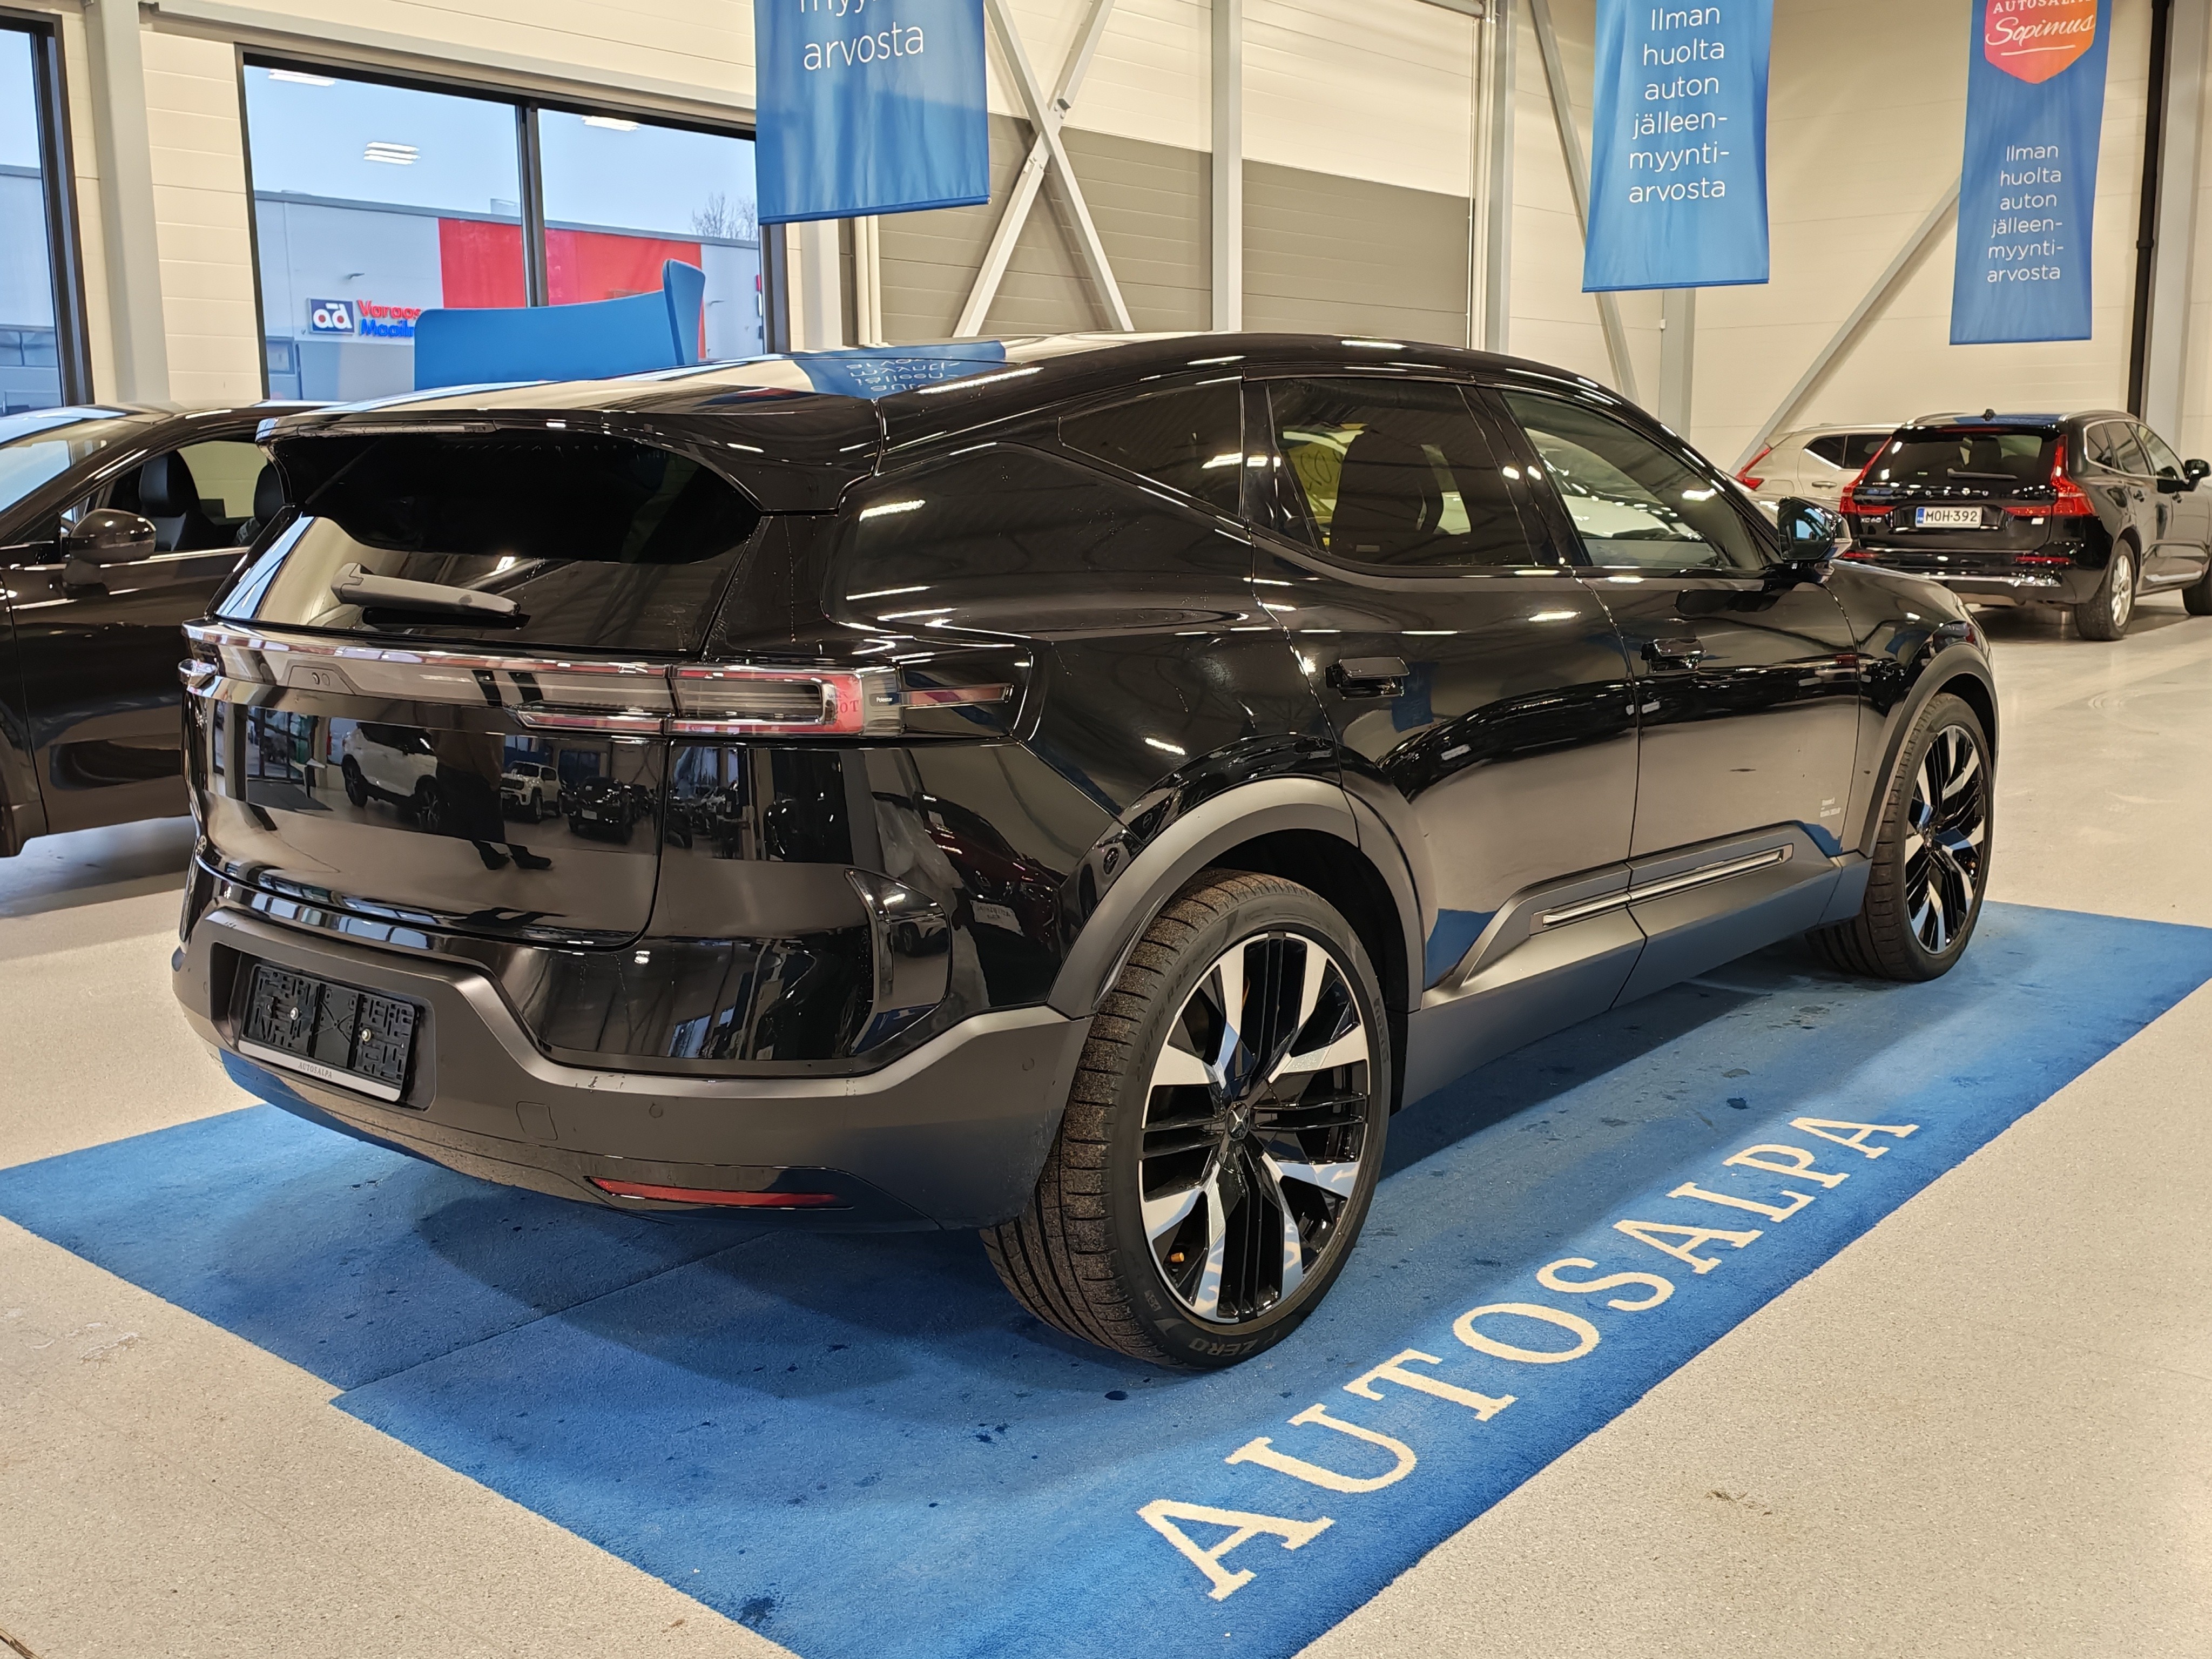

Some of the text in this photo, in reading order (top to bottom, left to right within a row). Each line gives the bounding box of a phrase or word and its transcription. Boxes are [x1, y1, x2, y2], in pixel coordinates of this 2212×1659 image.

[1651, 7, 1720, 31] Ilman
[1985, 14, 2095, 47] Sopimus
[804, 21, 924, 70] arvosta
[1643, 38, 1724, 66] huolta
[1644, 76, 1719, 100] auton
[1632, 111, 1728, 140] jälleen-
[1629, 141, 1730, 172] myynti-
[2006, 145, 2059, 163] Ilman
[2000, 167, 2062, 187] huolta
[1629, 177, 1725, 203] arvosta
[2000, 192, 2057, 211] auton
[1991, 217, 2063, 238] jälleen-
[1988, 239, 2064, 262] myynti-
[1987, 264, 2061, 283] arvosta
[356, 299, 421, 320] Varaos
[1925, 510, 1978, 522] MOH-392
[298, 1062, 332, 1079] AUTOSALPA
[1136, 1116, 1920, 1602] AUTOSALPA
